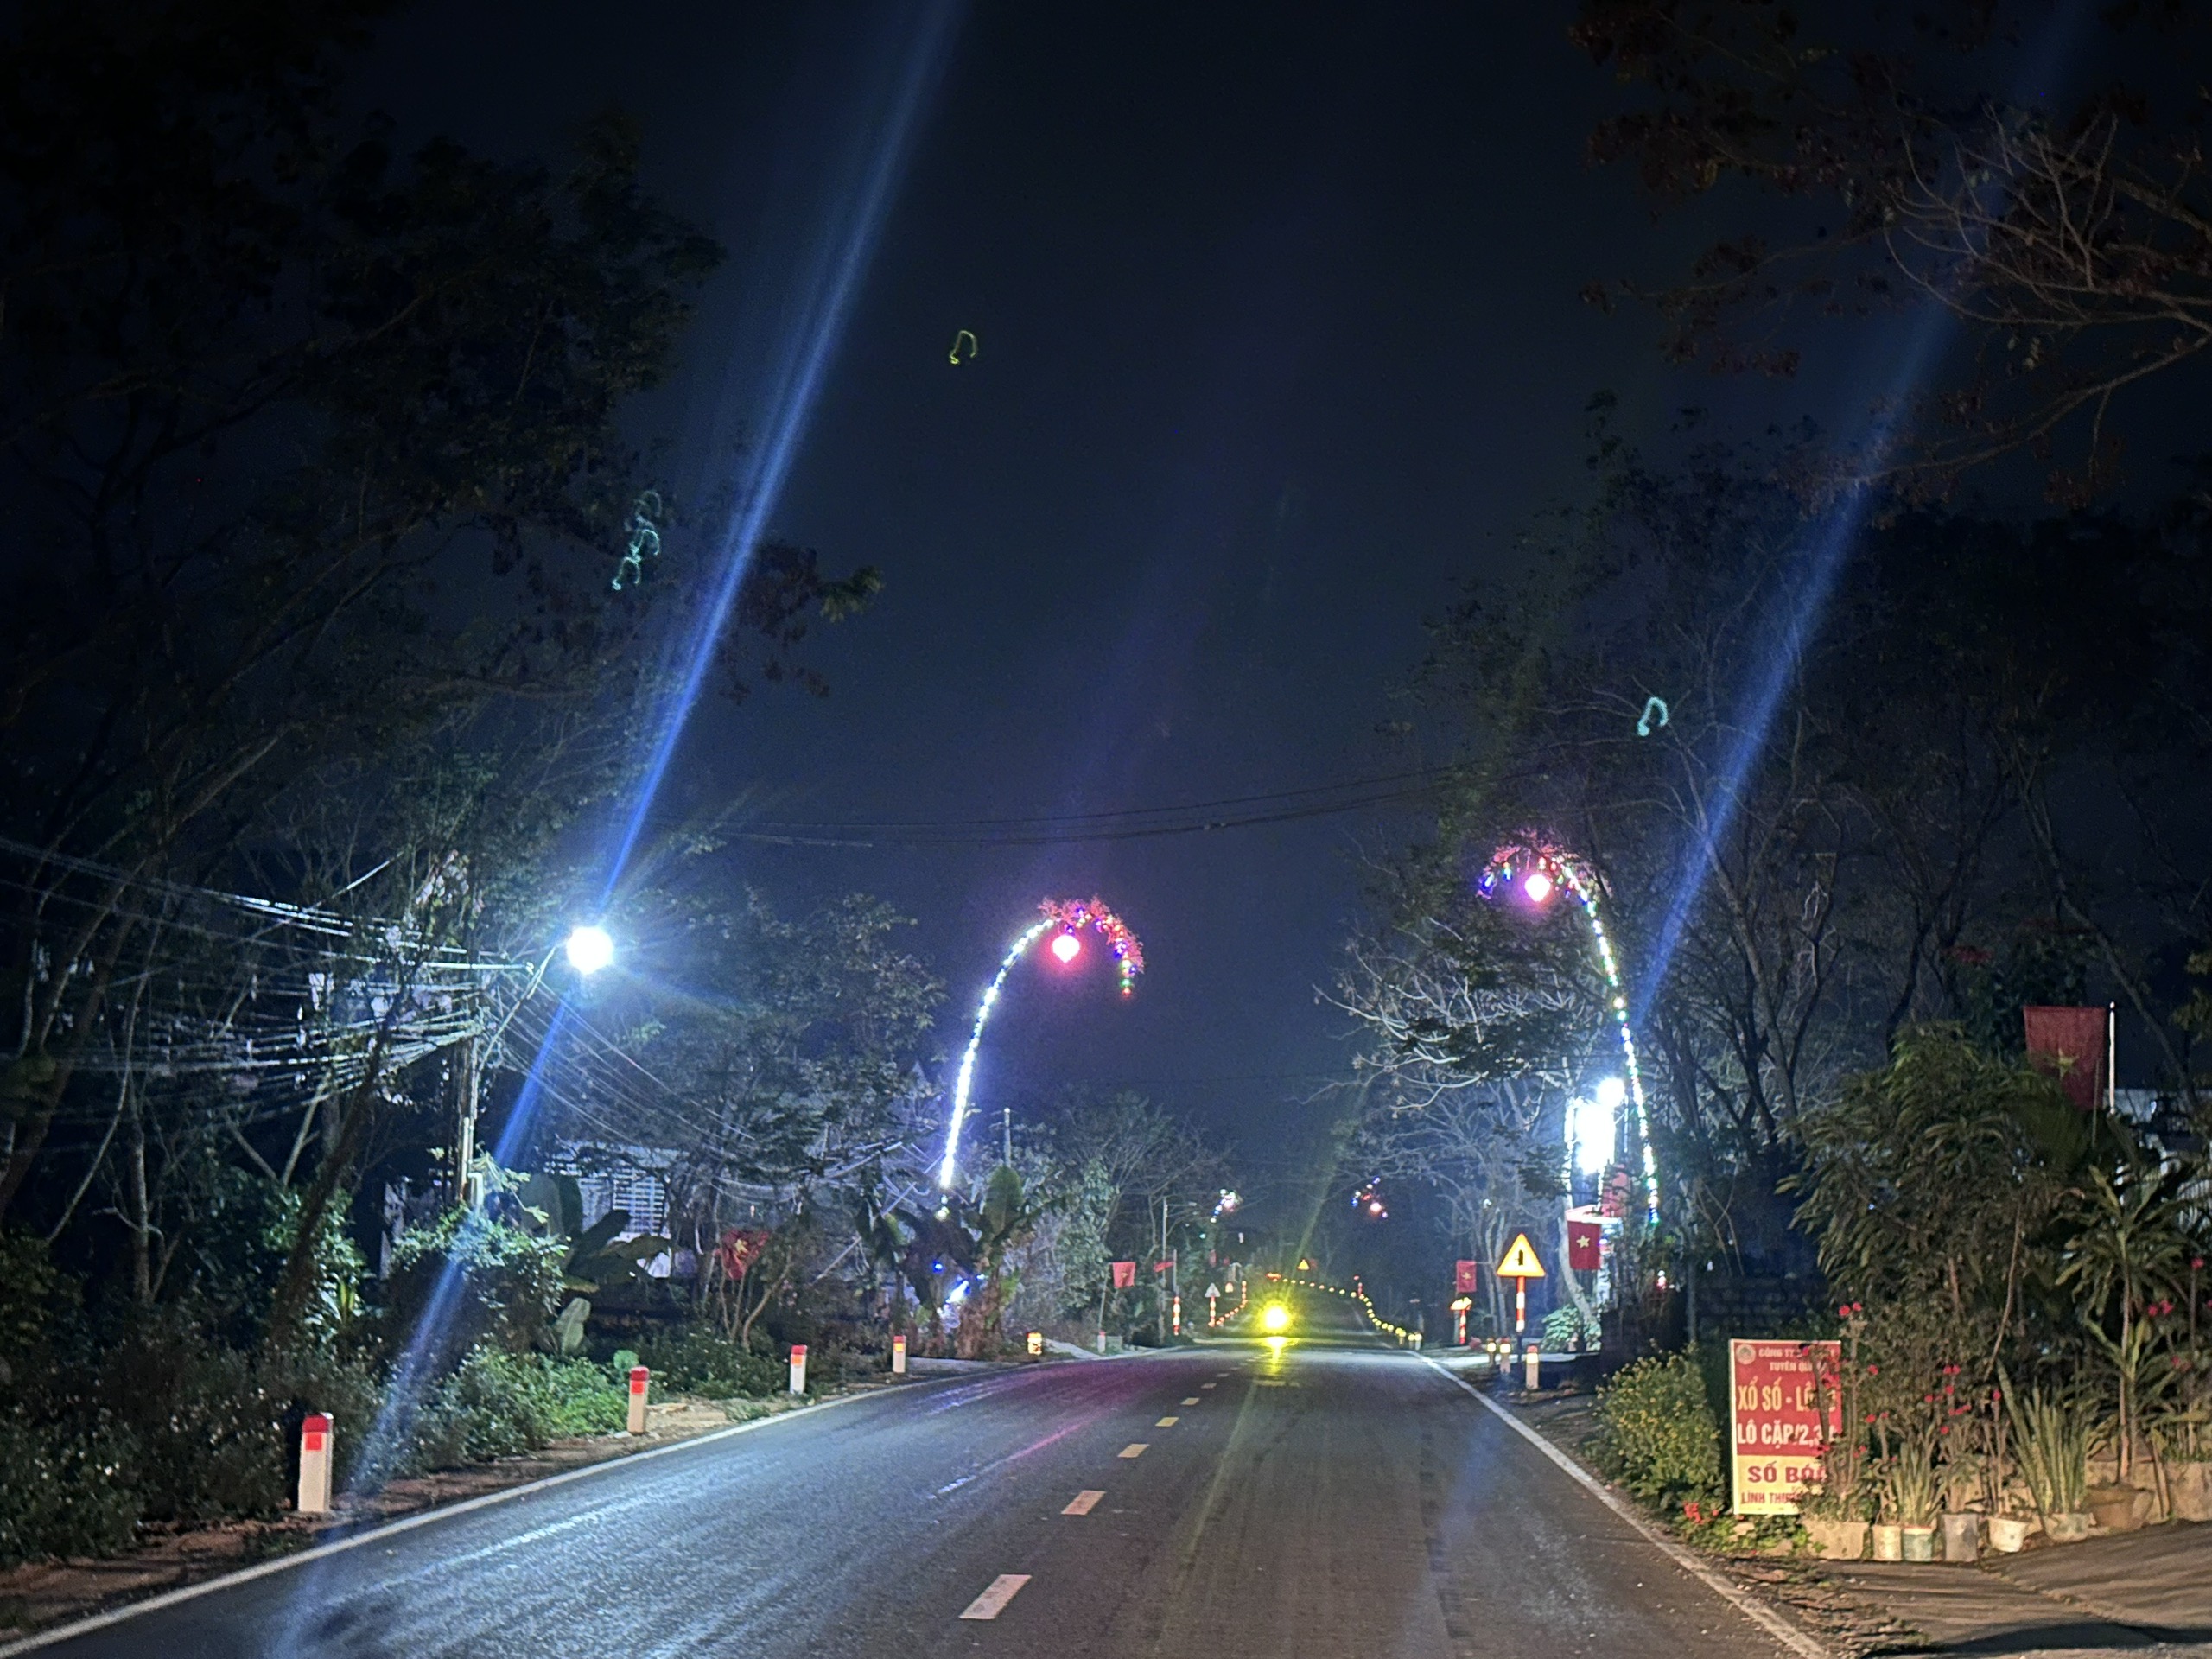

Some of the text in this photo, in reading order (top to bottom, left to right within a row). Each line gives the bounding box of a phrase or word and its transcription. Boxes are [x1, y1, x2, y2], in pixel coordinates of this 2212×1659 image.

[1770, 1361, 1796, 1371] TUYÊN
[1738, 1375, 1758, 1411] XỔ
[1762, 1376, 1783, 1411] SỐ
[1737, 1418, 1757, 1445] LÔ
[1747, 1460, 1777, 1483] SỐ
